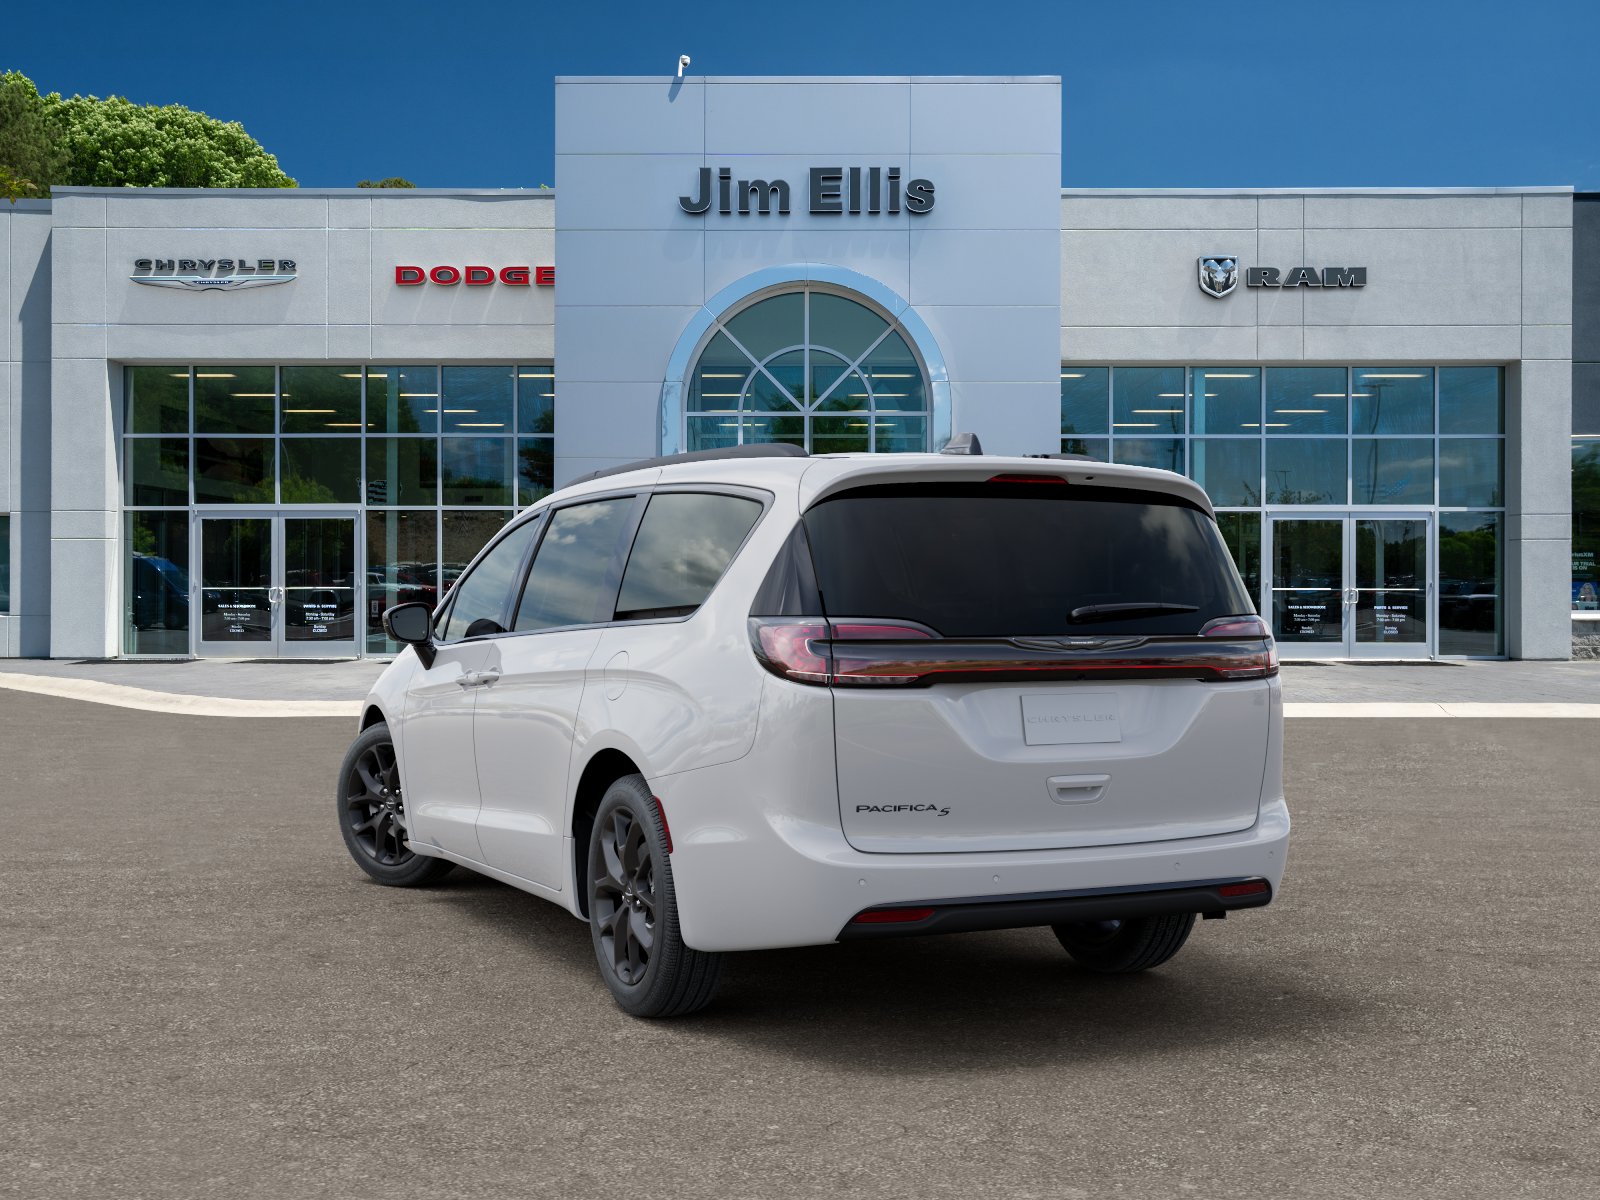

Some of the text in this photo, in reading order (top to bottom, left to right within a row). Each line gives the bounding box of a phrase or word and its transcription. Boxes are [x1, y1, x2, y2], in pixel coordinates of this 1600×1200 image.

[679, 167, 935, 214] Jim Ellis
[135, 258, 297, 271] CHRYSLER
[396, 266, 555, 286] DODGE
[1247, 267, 1367, 287] RAM
[856, 804, 951, 817] PACIFICA S
